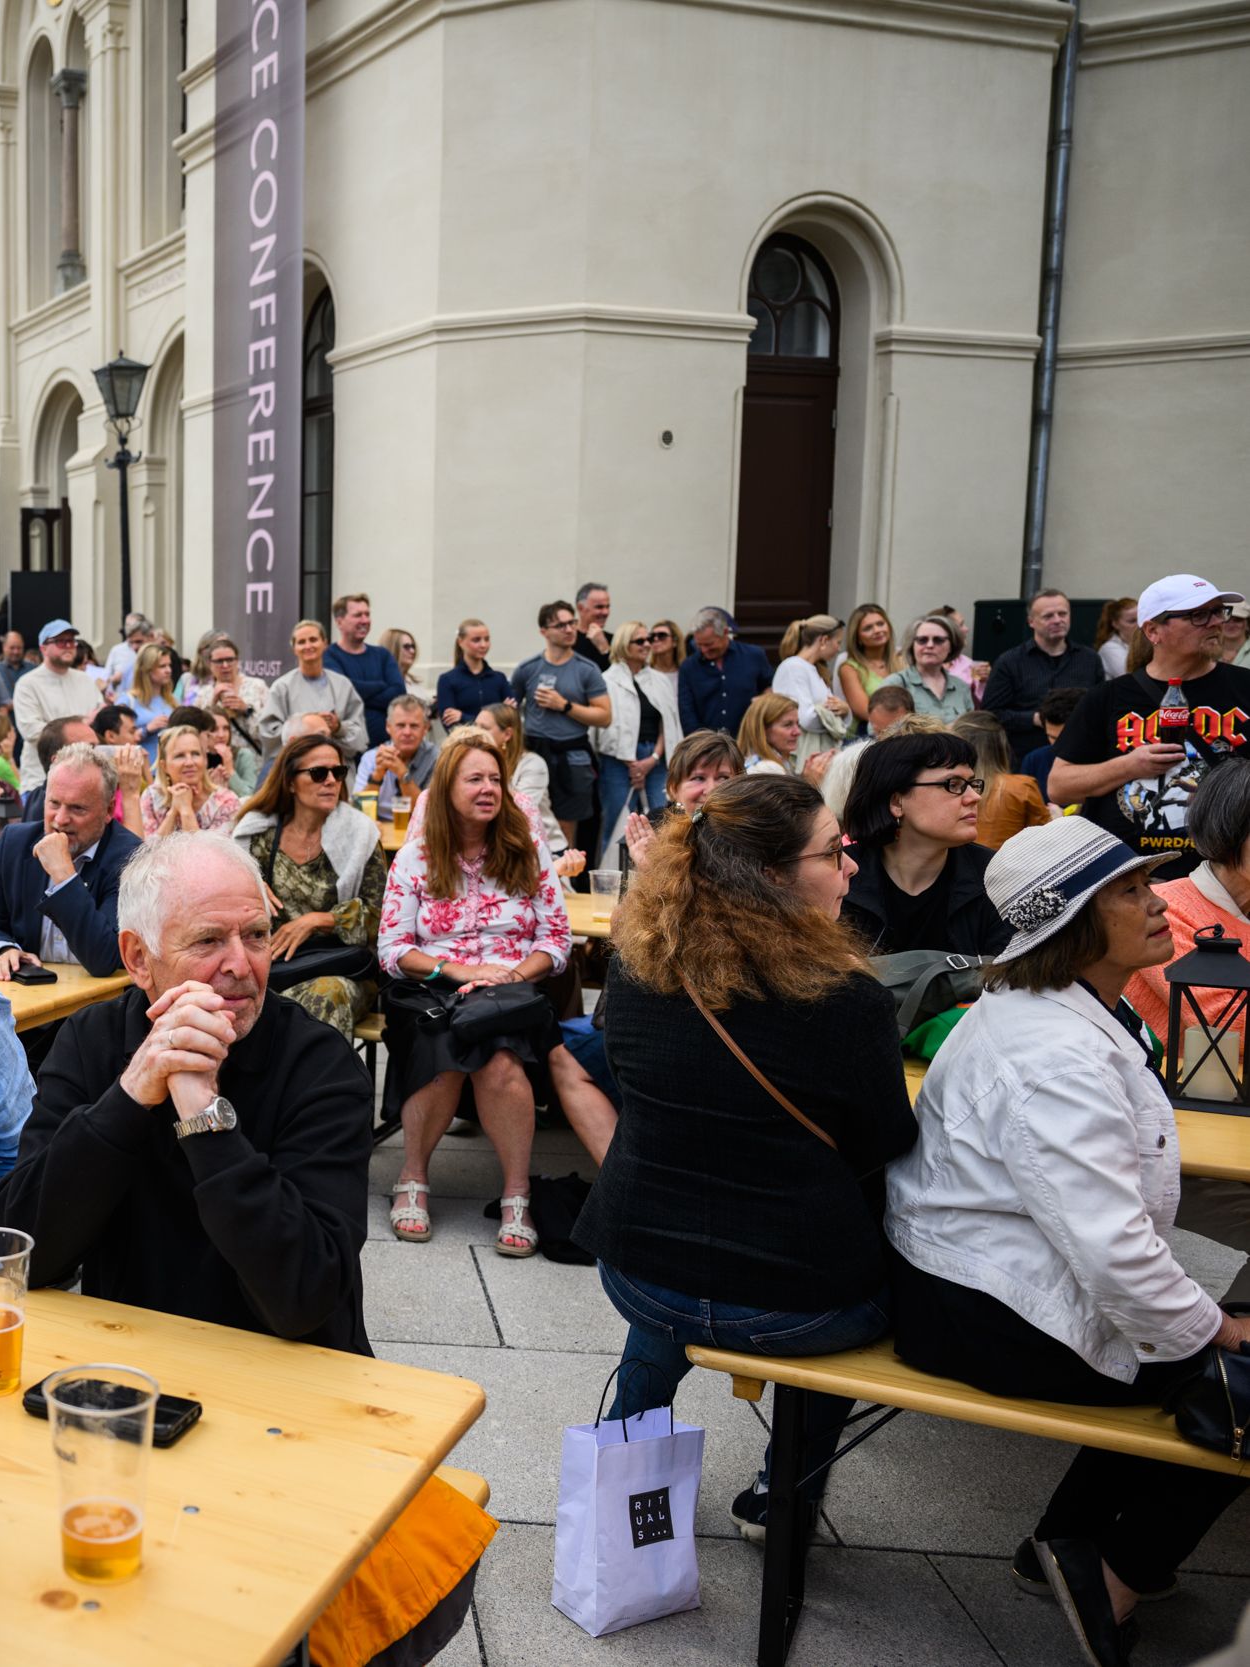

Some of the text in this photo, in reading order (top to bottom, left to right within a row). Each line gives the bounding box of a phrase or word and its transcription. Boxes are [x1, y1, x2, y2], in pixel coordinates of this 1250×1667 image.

[245, 0, 280, 614] CE CONFERENCE
[243, 660, 282, 677] AUGUST
